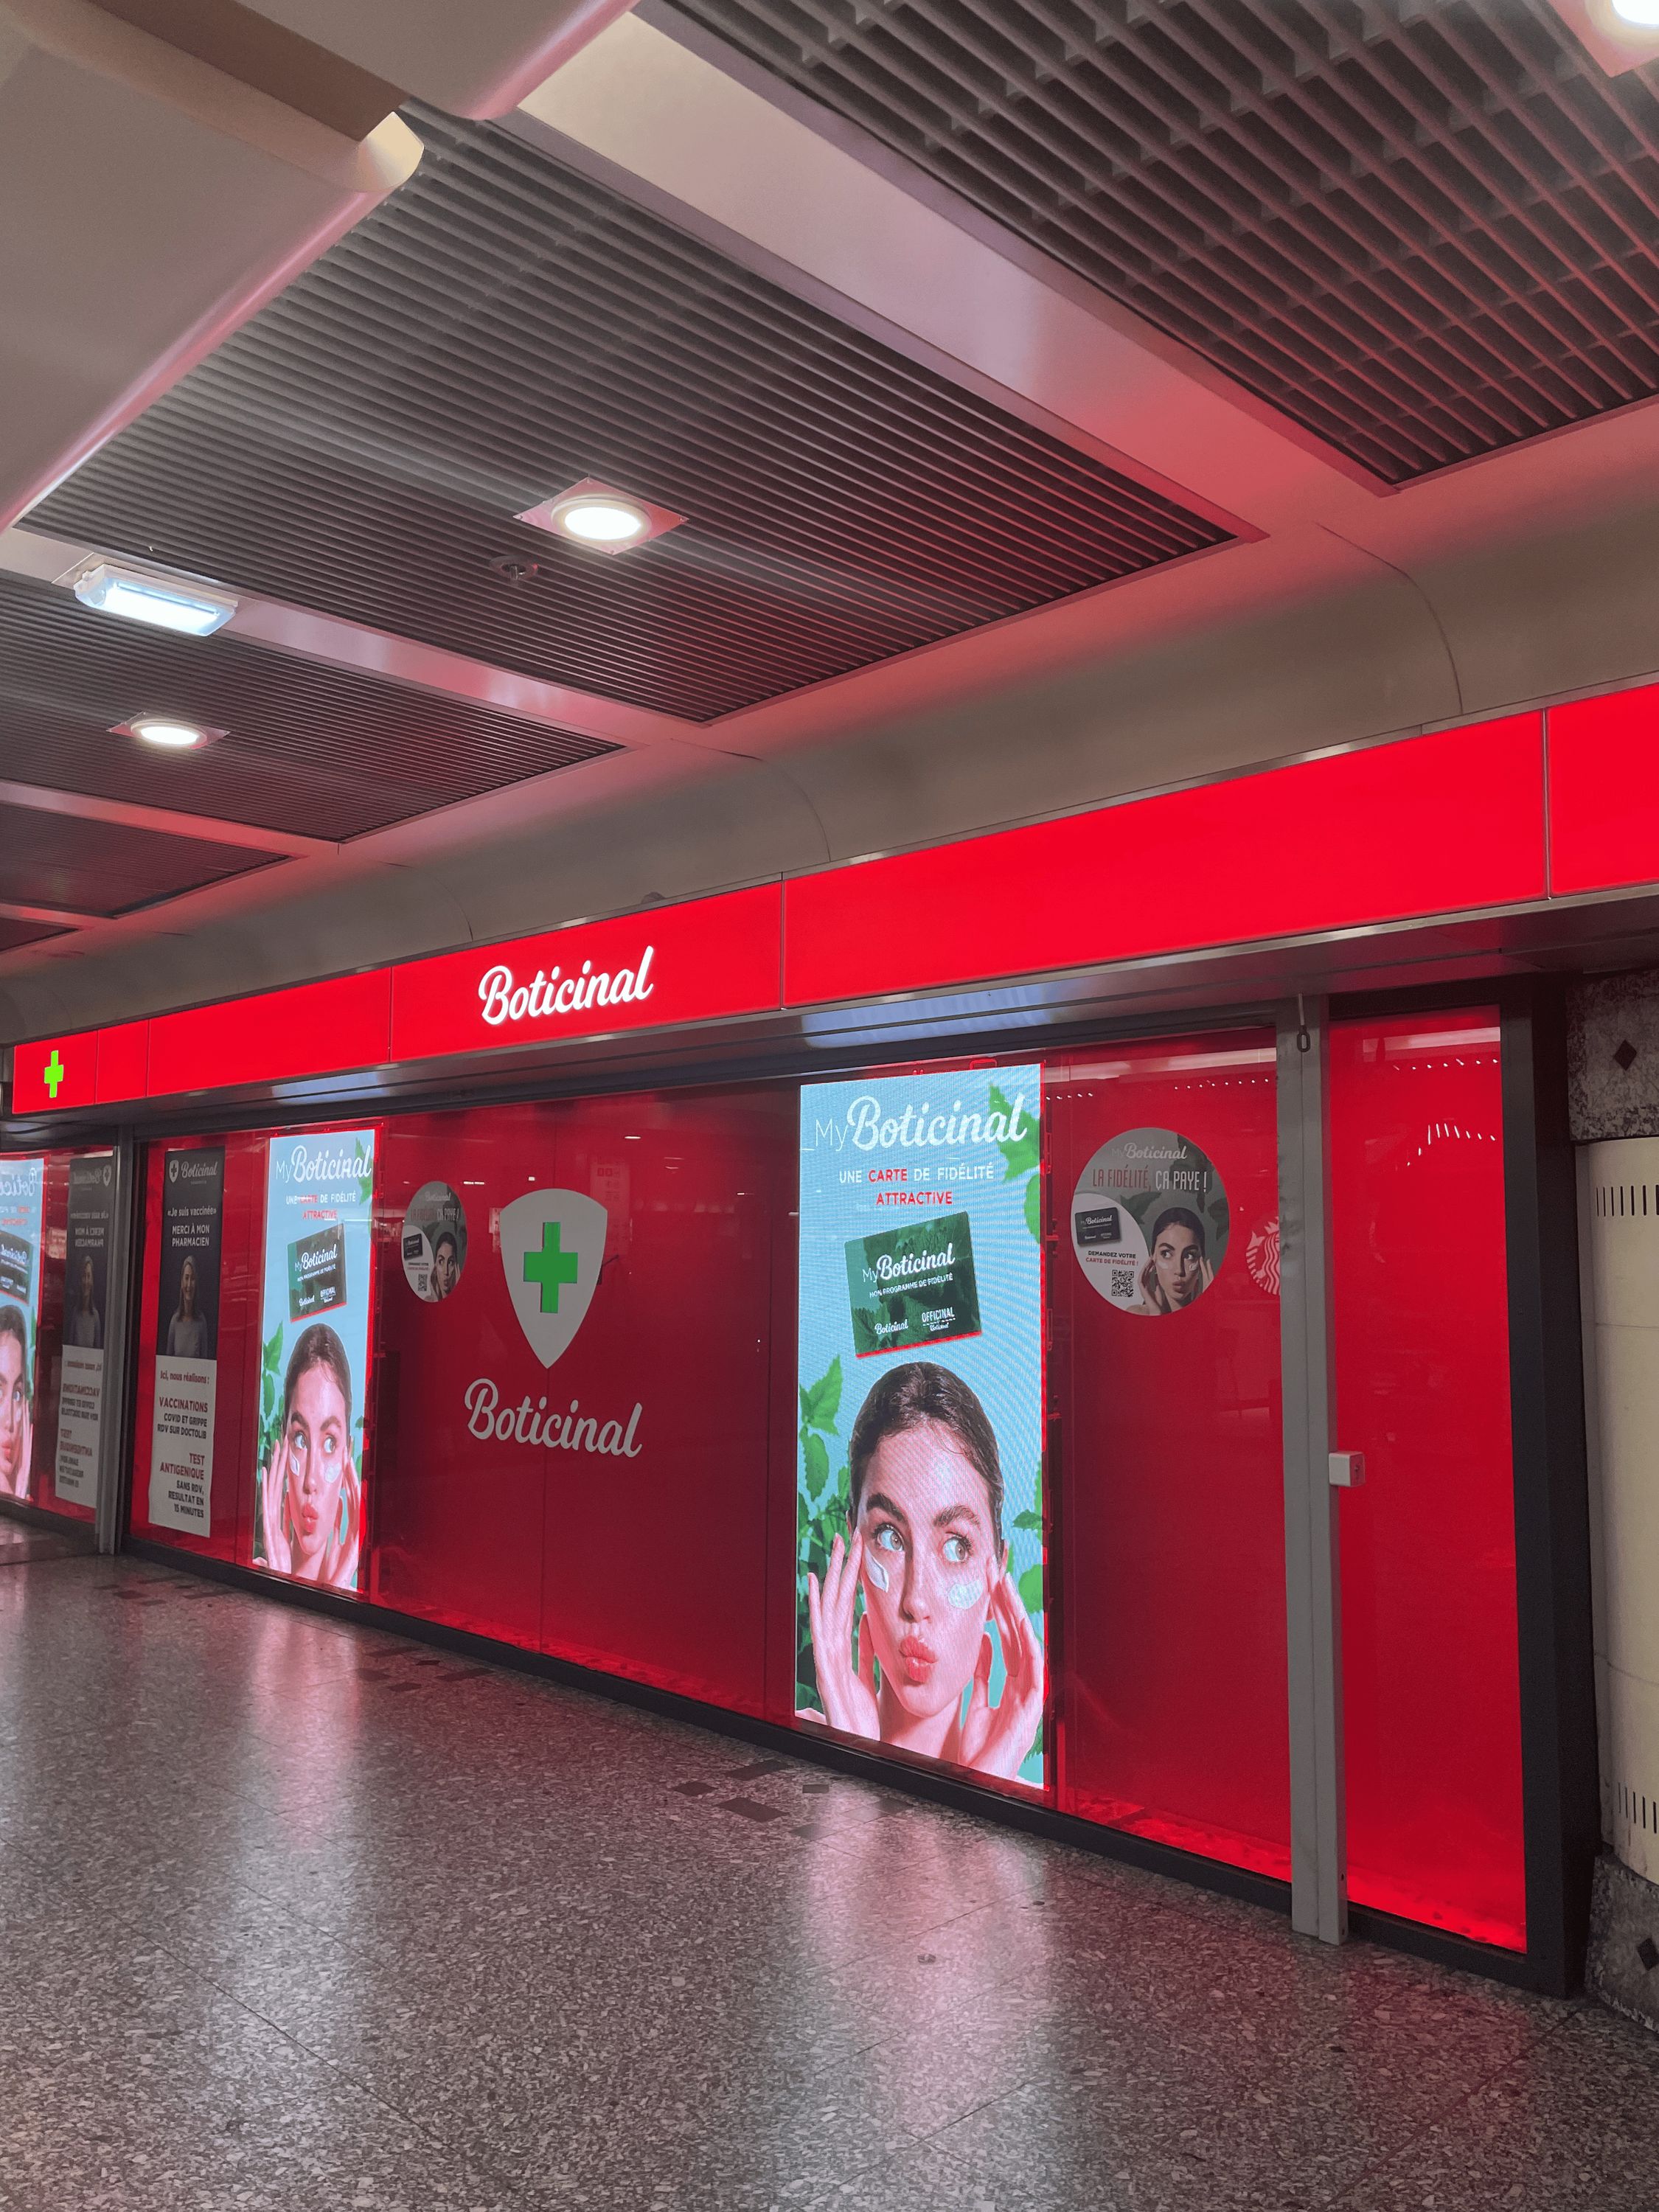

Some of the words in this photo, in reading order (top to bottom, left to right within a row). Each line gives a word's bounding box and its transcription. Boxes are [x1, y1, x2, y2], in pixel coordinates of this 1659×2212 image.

[479, 945, 654, 1025] Boticinal
[181, 1161, 218, 1178] Boticinal
[839, 1169, 862, 1183] UNE
[868, 1169, 908, 1183] CARTE
[914, 1167, 930, 1181] DE
[937, 1163, 995, 1180] FIDÉLITÉ
[1093, 1169, 1104, 1186] LA
[1107, 1164, 1152, 1192] FIDÉLITÉ,
[1155, 1170, 1169, 1191] ÇA
[1173, 1171, 1200, 1191] PAYE
[286, 1195, 297, 1205] UNE
[320, 1194, 328, 1203] DE
[330, 1191, 355, 1203] FIDÉLITÉ
[876, 1192, 953, 1205] ATTRACTIVE
[178, 1206, 189, 1217] suis
[302, 1210, 337, 1220] ATTRACTIVE
[172, 1225, 189, 1235] MERCI
[192, 1222, 195, 1234] À
[196, 1224, 209, 1234] MON
[172, 1237, 209, 1247] PHARMACIEN
[883, 1281, 919, 1295] PROGRAMME
[919, 1279, 928, 1287] DE
[922, 1307, 955, 1323] OFFICINAL
[874, 1318, 908, 1335] Boticinal
[159, 1397, 208, 1413] VACCINATIONS
[164, 1413, 181, 1423] COVID
[182, 1414, 189, 1424] ET
[189, 1416, 207, 1427] GRIPPE
[465, 1378, 643, 1458] Boticinal
[157, 1423, 169, 1433] RDV
[170, 1425, 180, 1435] SUR
[181, 1427, 206, 1439] DOCTOLIB
[189, 1453, 205, 1466] TEST
[160, 1461, 204, 1480] ANTIGENIQUE
[177, 1480, 190, 1491] SANS
[168, 1490, 195, 1505] RESULTAT
[196, 1496, 204, 1506] EN
[181, 1505, 204, 1518] MINUTES
